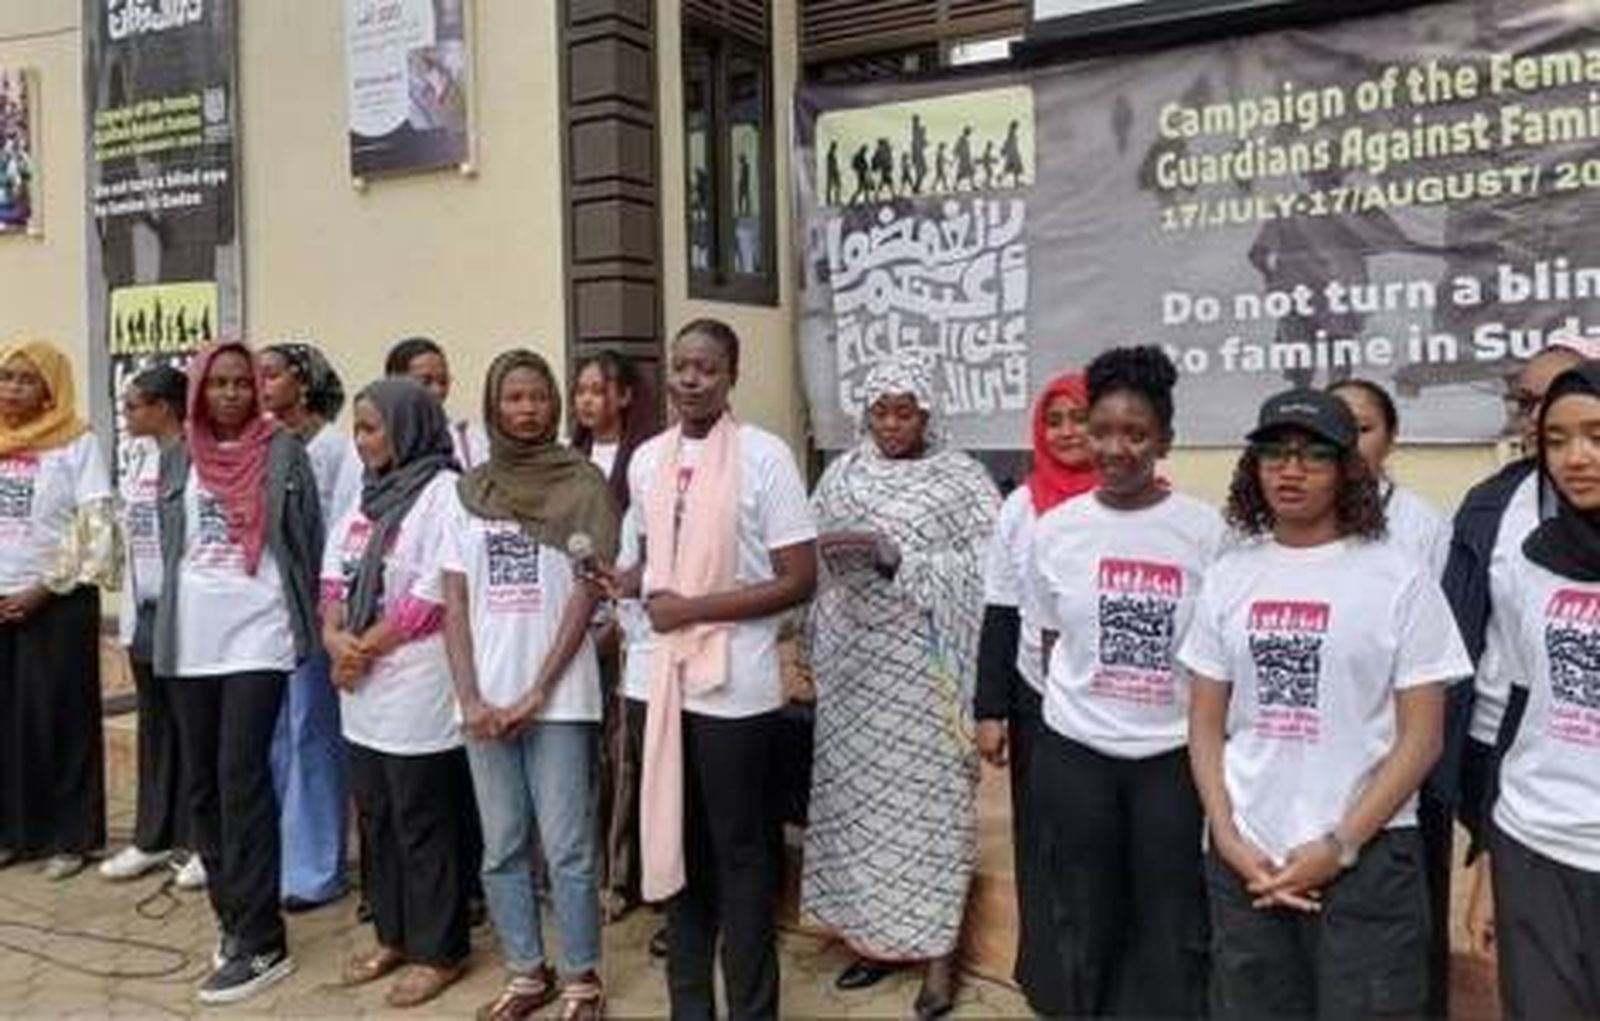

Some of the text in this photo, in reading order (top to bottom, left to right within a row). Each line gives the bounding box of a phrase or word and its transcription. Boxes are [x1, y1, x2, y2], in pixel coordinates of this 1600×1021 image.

[1158, 50, 1600, 139] Campaign of the Fema
[1156, 91, 1600, 189] Guardians Against Fami
[1553, 158, 1600, 190] 20
[1161, 291, 1221, 325] Do
[1235, 284, 1314, 320] not
[1324, 280, 1437, 314] turn
[1452, 275, 1481, 306] a
[1220, 329, 1393, 372] famine
[1408, 323, 1459, 363] in
[1472, 315, 1600, 361] Sud
